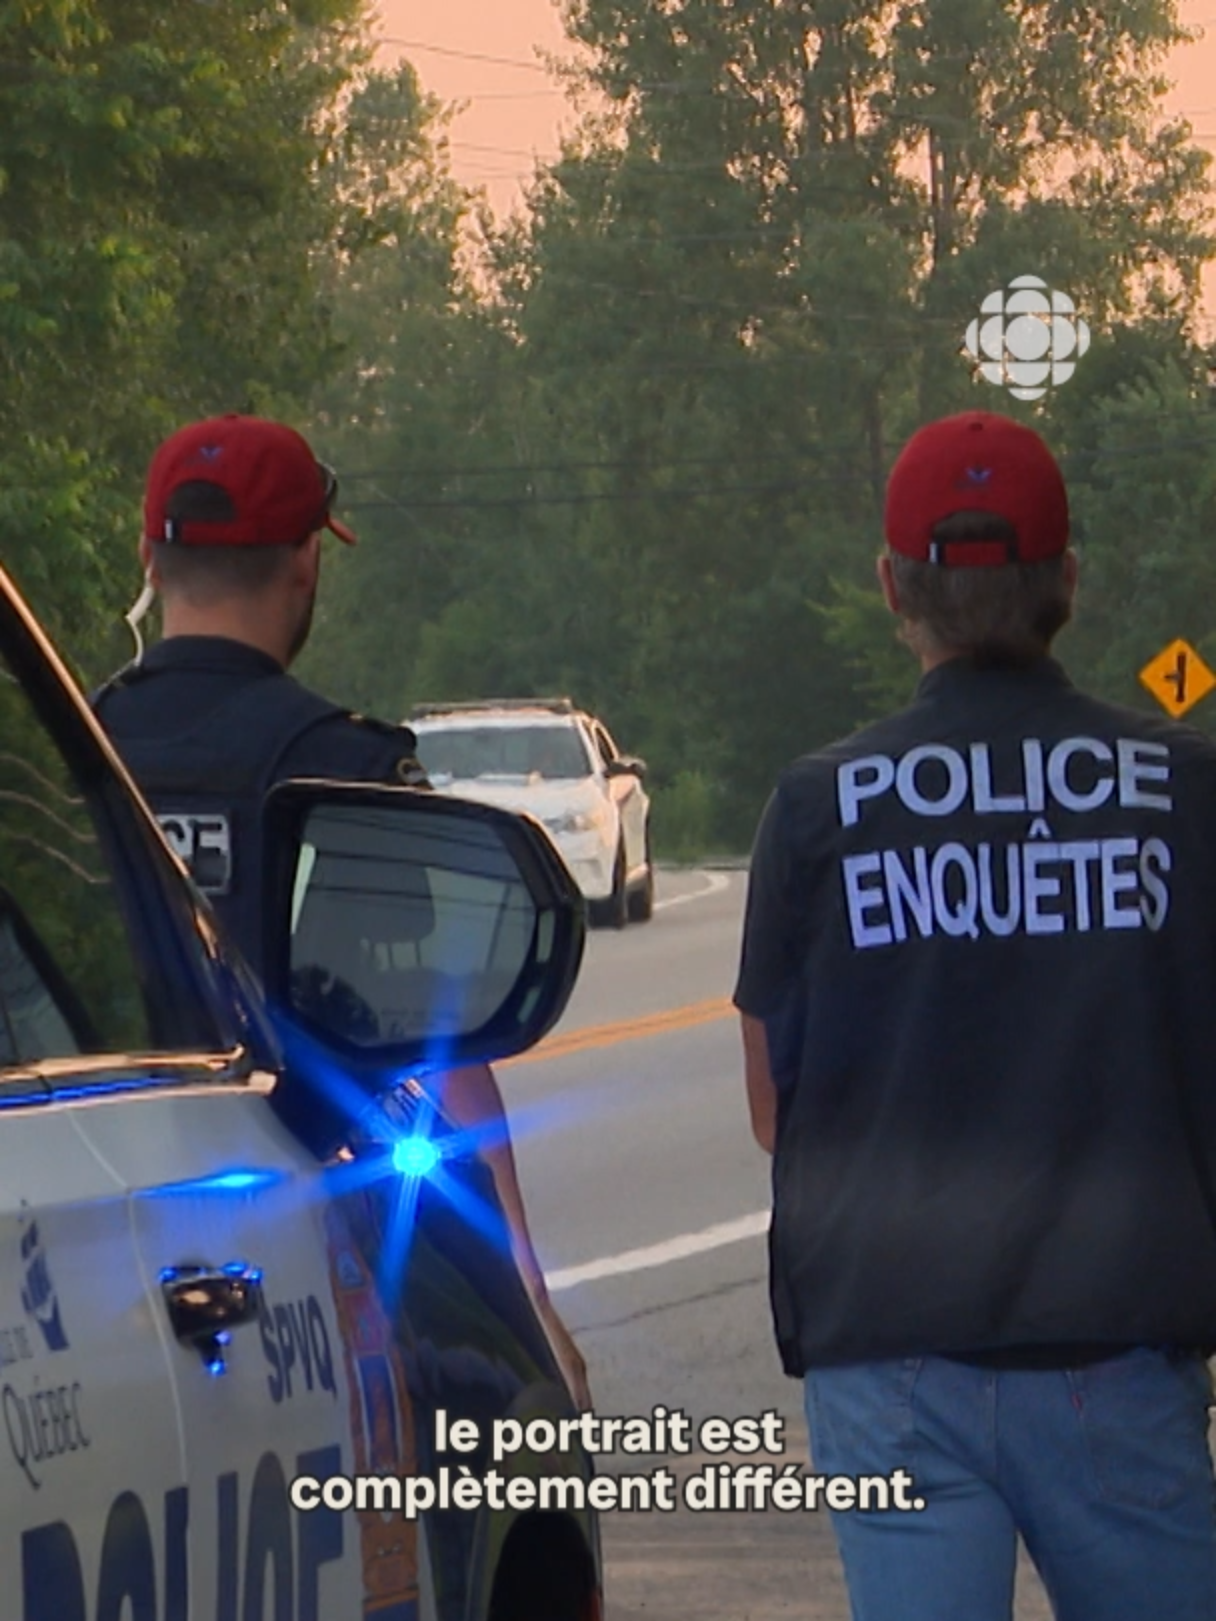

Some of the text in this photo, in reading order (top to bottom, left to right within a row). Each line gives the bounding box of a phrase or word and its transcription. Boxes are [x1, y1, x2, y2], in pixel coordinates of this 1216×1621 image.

[836, 736, 1172, 828] POLICE
[842, 817, 1171, 949] ENQUÊTES
[258, 1294, 338, 1404] SPVQ
